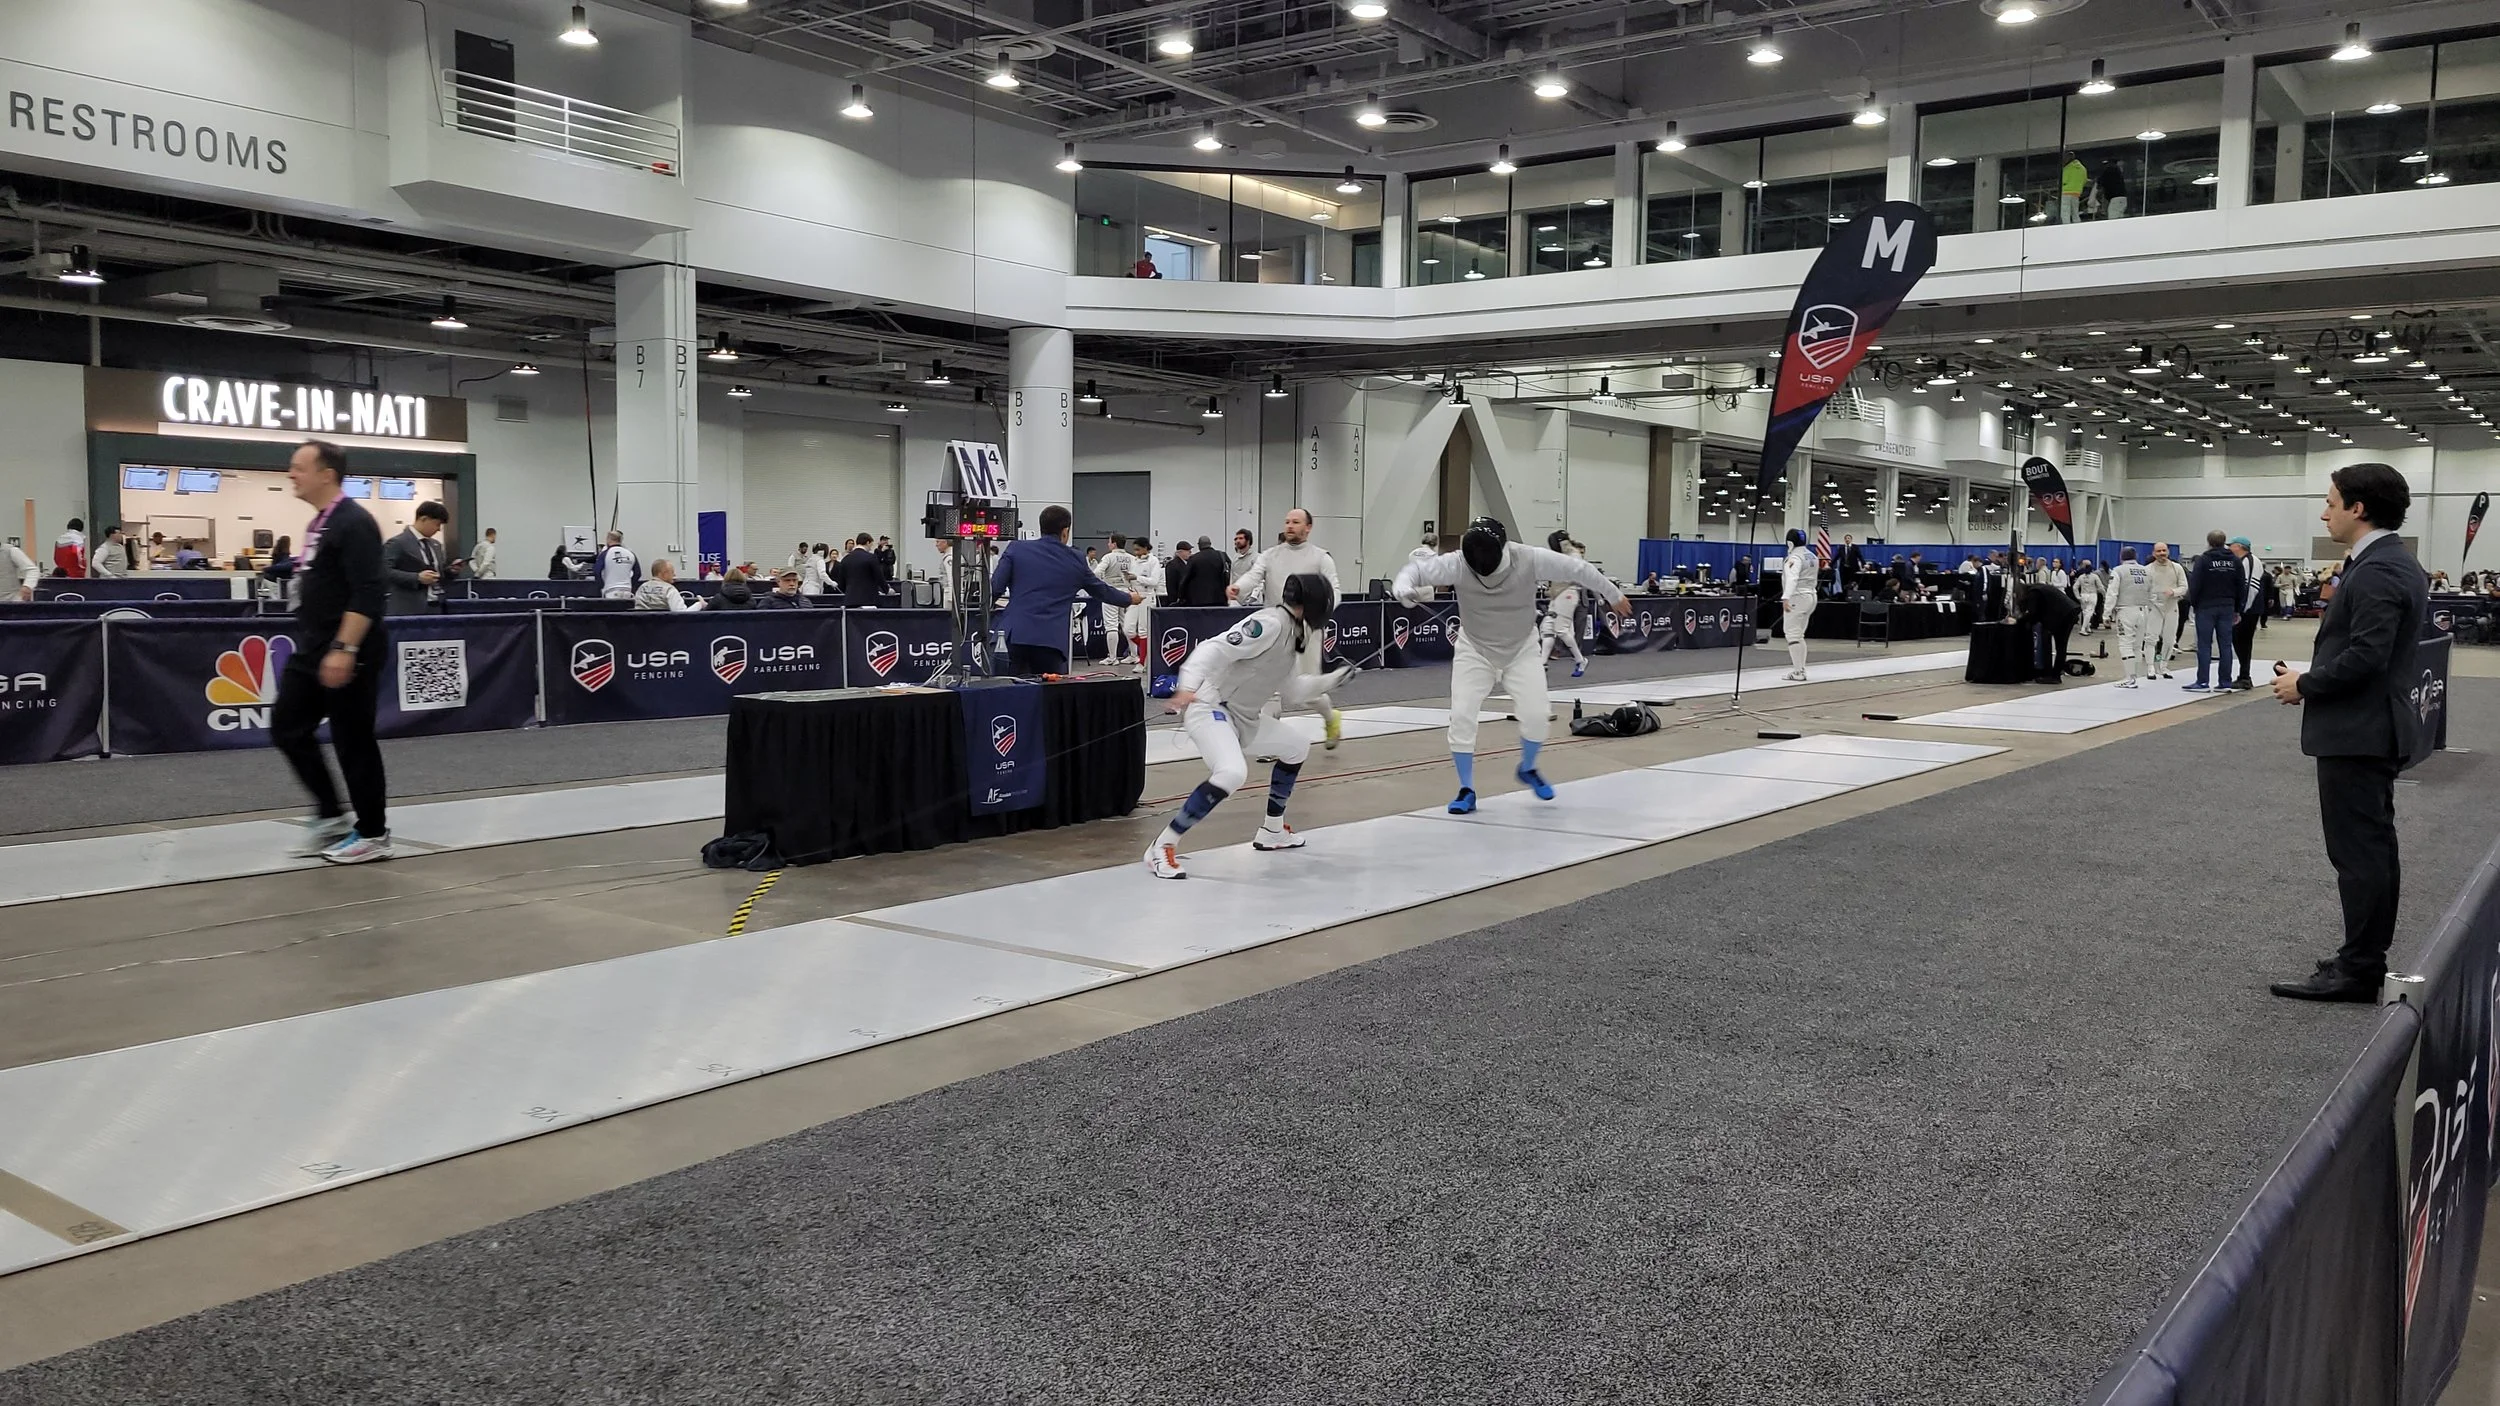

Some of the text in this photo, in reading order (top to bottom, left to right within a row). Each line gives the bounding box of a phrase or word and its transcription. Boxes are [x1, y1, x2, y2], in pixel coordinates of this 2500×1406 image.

[10, 91, 288, 175] RESTROOMS
[1861, 216, 1915, 273] M
[1800, 373, 1834, 384] USA
[163, 375, 426, 437] CRAVE-IN-NATI
[988, 450, 999, 465] 4
[958, 447, 998, 497] M
[2025, 464, 2049, 476] BOUT
[2479, 495, 2486, 508] P
[988, 524, 998, 535] 05
[1342, 626, 1368, 637] USA
[1413, 624, 1439, 635] USA
[759, 645, 815, 661] USA
[627, 651, 690, 668] USA
[754, 663, 821, 673] PARAFENCING
[634, 671, 684, 680] FENCING
[995, 760, 1015, 770] USA
